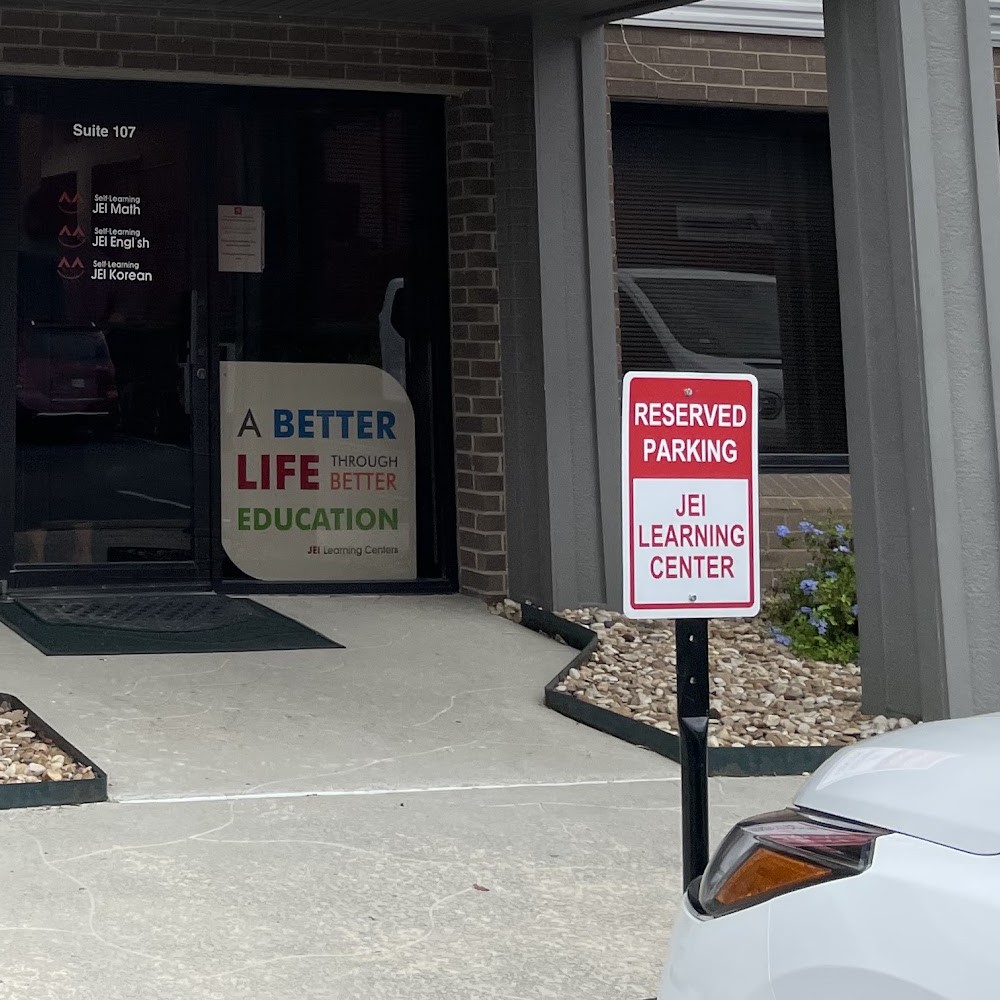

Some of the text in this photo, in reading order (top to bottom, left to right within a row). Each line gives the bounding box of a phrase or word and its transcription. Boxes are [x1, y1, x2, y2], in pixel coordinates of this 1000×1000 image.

[73, 123, 136, 138] Suite 107
[94, 194, 141, 204] Self-Learning
[92, 203, 141, 215] JEI Math
[94, 227, 141, 238] Self-Learning
[92, 236, 107, 247] JEI
[93, 260, 140, 270] Self-Learning
[91, 269, 153, 282] JEI Korean
[237, 407, 397, 440] A BETTER
[634, 402, 747, 428] RESERVED
[642, 438, 738, 463] PARKING
[330, 455, 398, 468] THROUGH
[237, 454, 320, 490] LIFE
[330, 472, 397, 491] BETTER
[675, 493, 706, 517] JEI
[237, 507, 399, 531] EDUCATION
[638, 524, 745, 548] LEARNING
[307, 545, 399, 556] JEI Learning Centers
[650, 555, 735, 579] CENTER
